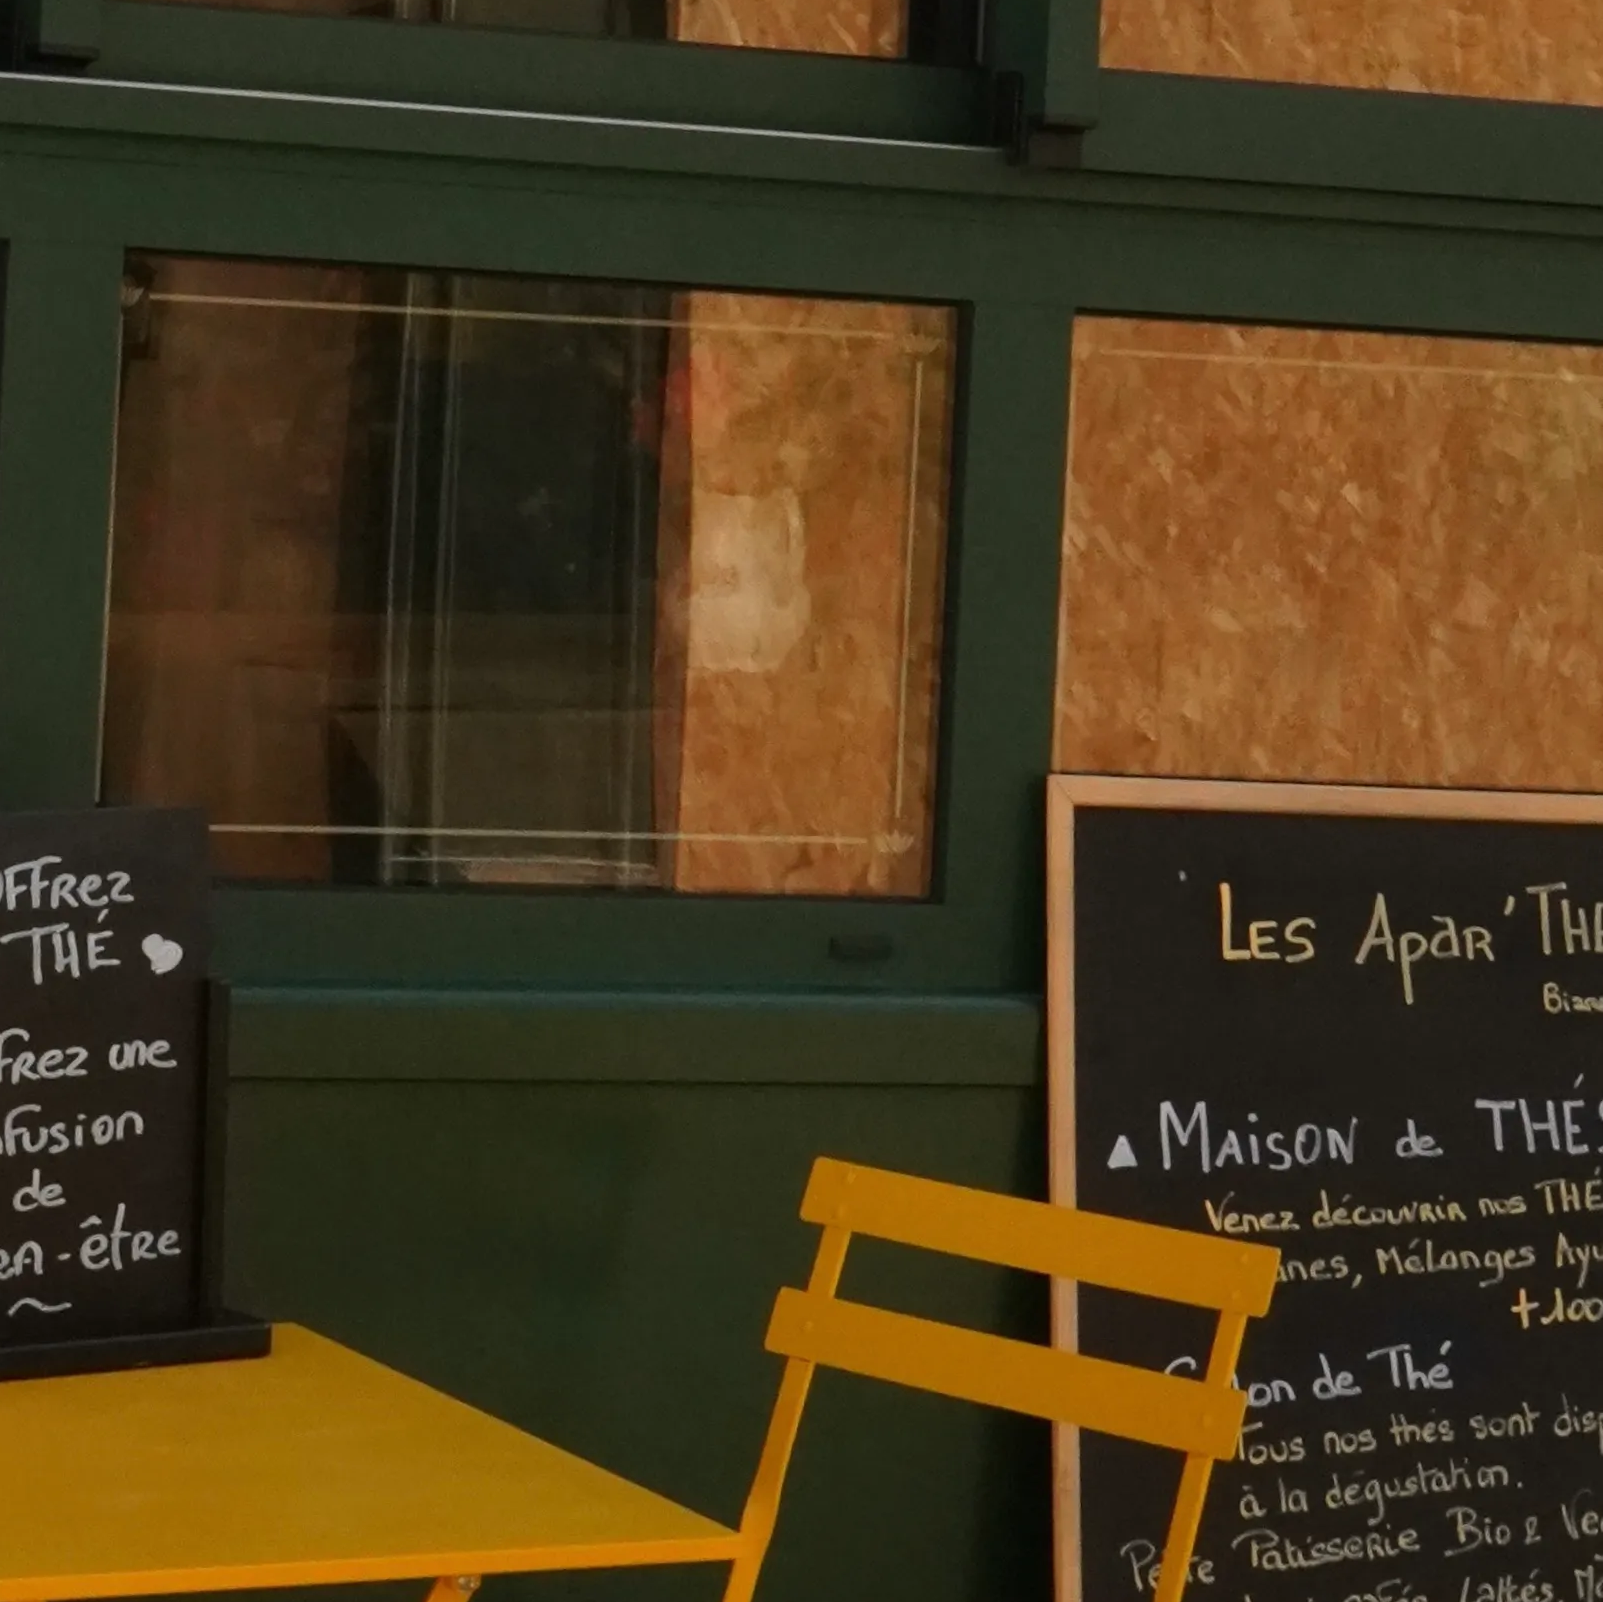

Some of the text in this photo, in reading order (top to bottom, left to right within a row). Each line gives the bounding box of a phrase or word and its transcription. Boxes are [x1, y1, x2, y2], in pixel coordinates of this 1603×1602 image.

[0, 909, 122, 985] THÉ
[109, 1038, 178, 1071] une
[1395, 1119, 1444, 1159] de
[1474, 1072, 1603, 1156] THÉ
[12, 1168, 67, 1212] de
[1204, 1190, 1301, 1233] Venez
[1478, 1194, 1528, 1218] nos
[1312, 1352, 1362, 1399] de
[1367, 1339, 1455, 1391] Thé
[1323, 1428, 1378, 1455] nos
[1389, 1407, 1456, 1447] thés
[1468, 1400, 1542, 1440] sont
[1553, 1392, 1603, 1457] dis
[1239, 1484, 1268, 1519] à
[1278, 1476, 1309, 1513] la
[1444, 1505, 1512, 1558] Bio
